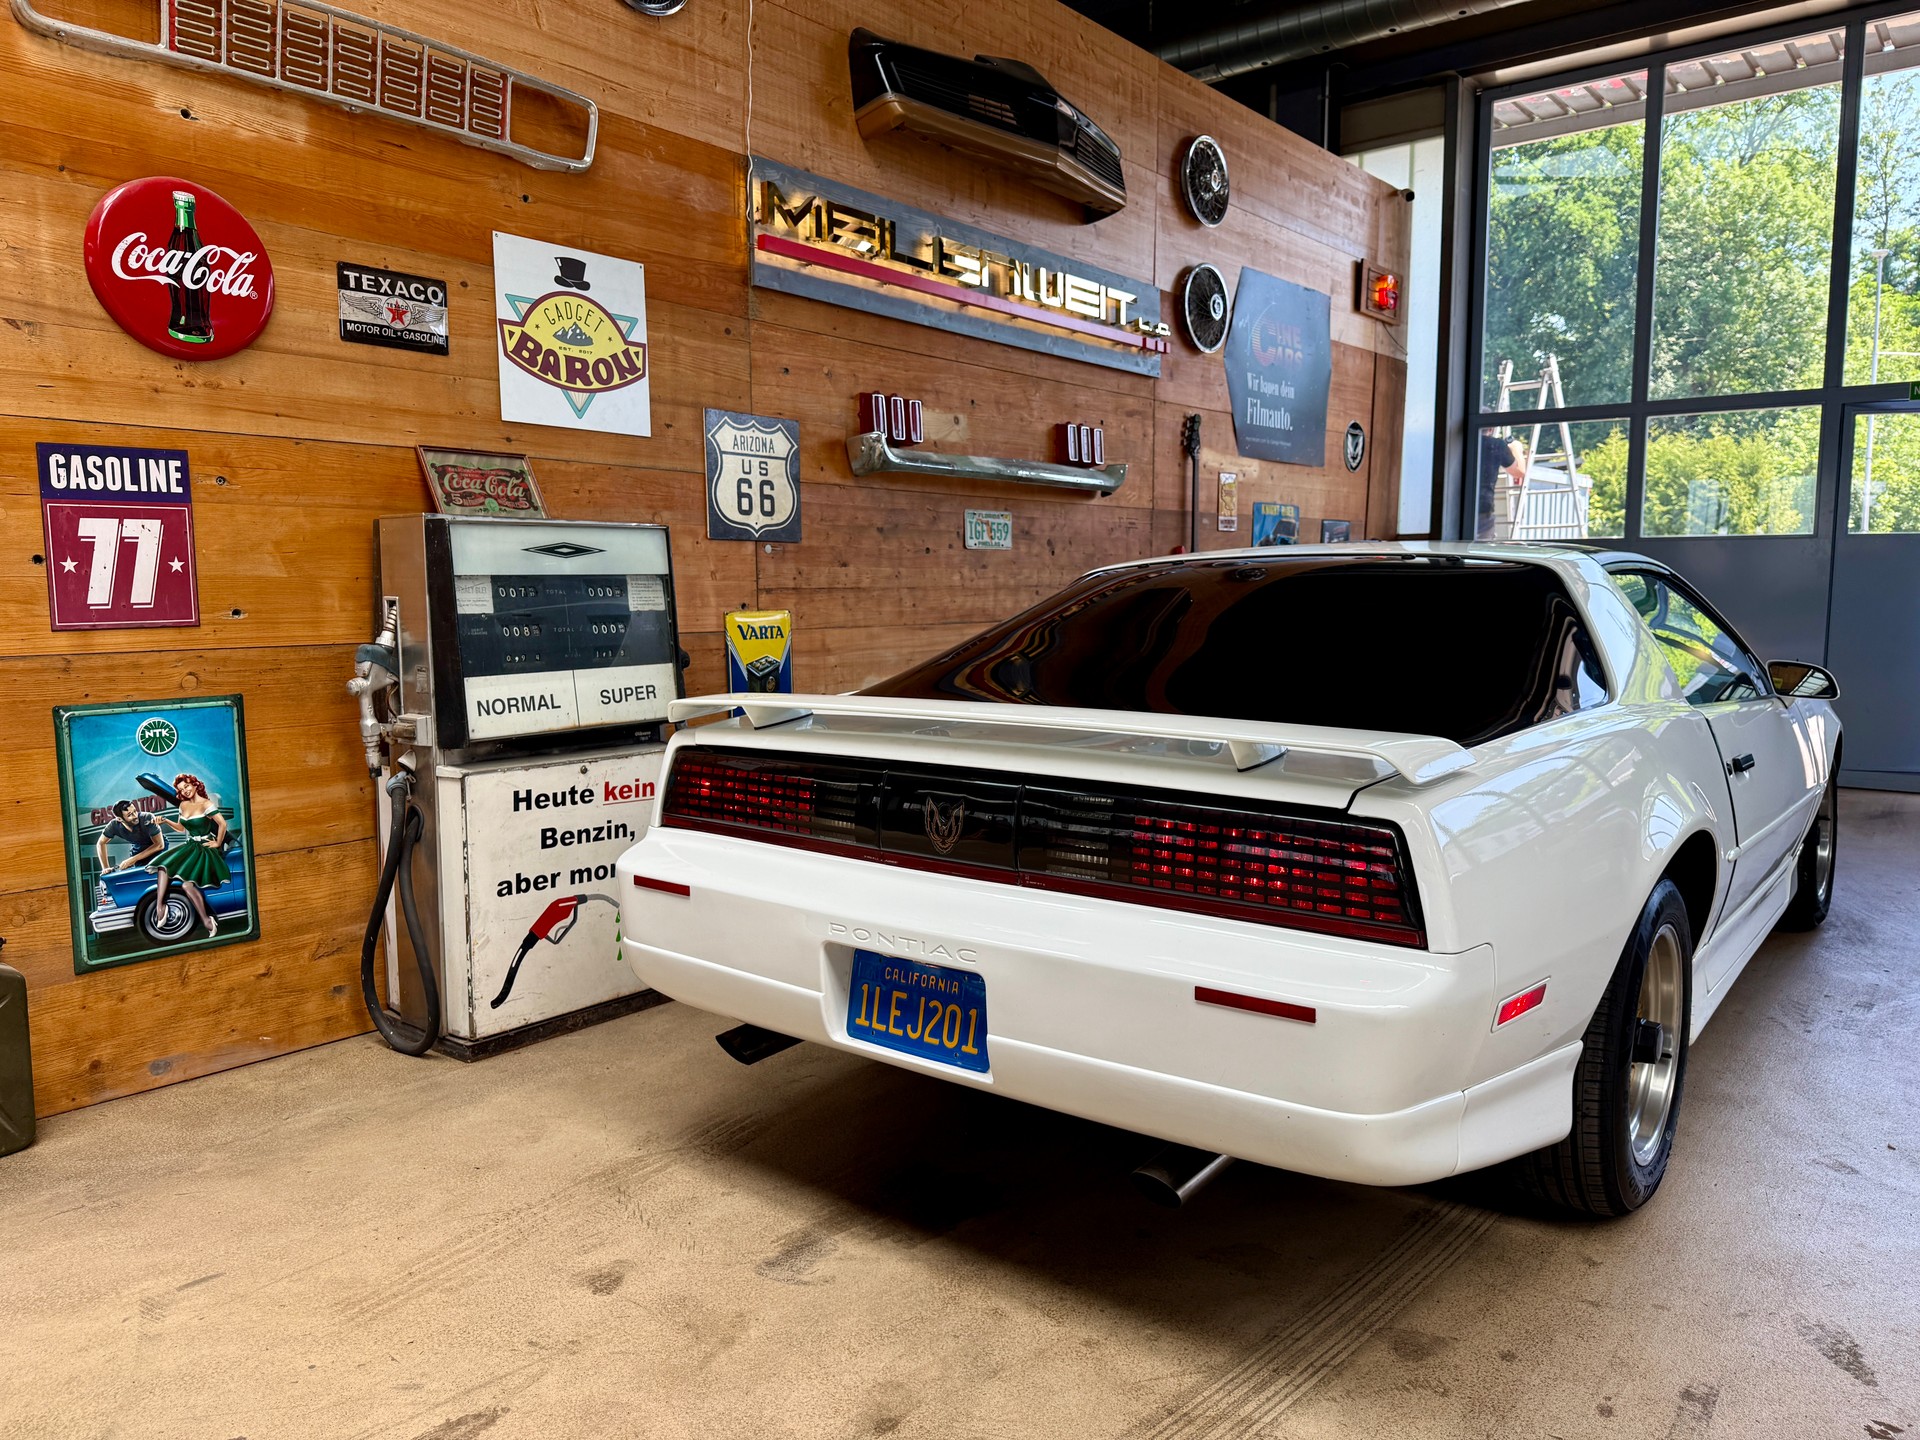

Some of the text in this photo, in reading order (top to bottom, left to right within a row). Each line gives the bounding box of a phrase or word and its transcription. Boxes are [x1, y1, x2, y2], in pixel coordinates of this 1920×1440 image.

[111, 232, 258, 298] Coca-Cola
[761, 181, 1138, 326] MEILENWEIT
[343, 271, 443, 303] TEXACO
[543, 301, 604, 332] GADGET
[346, 322, 446, 346] MOTOR OIL GASOLINE
[509, 329, 641, 387] BARON
[1247, 372, 1259, 391] Wir
[1281, 380, 1295, 399] dein
[1247, 397, 1293, 431] Filmauto.
[732, 434, 775, 453] ARIZONA
[49, 453, 183, 493] GASOLINE
[737, 478, 775, 517] 66
[737, 624, 784, 640] VARTA
[477, 693, 562, 717] NORMAL
[600, 684, 657, 705] SUPER
[144, 728, 170, 739] NTK
[512, 778, 655, 812] Heute kein
[540, 820, 636, 849] Benzin,
[496, 871, 561, 898] aber
[829, 922, 978, 964] PONTIAC
[885, 967, 959, 995] CALIFORNIA
[855, 983, 979, 1056] 1LEJ201
